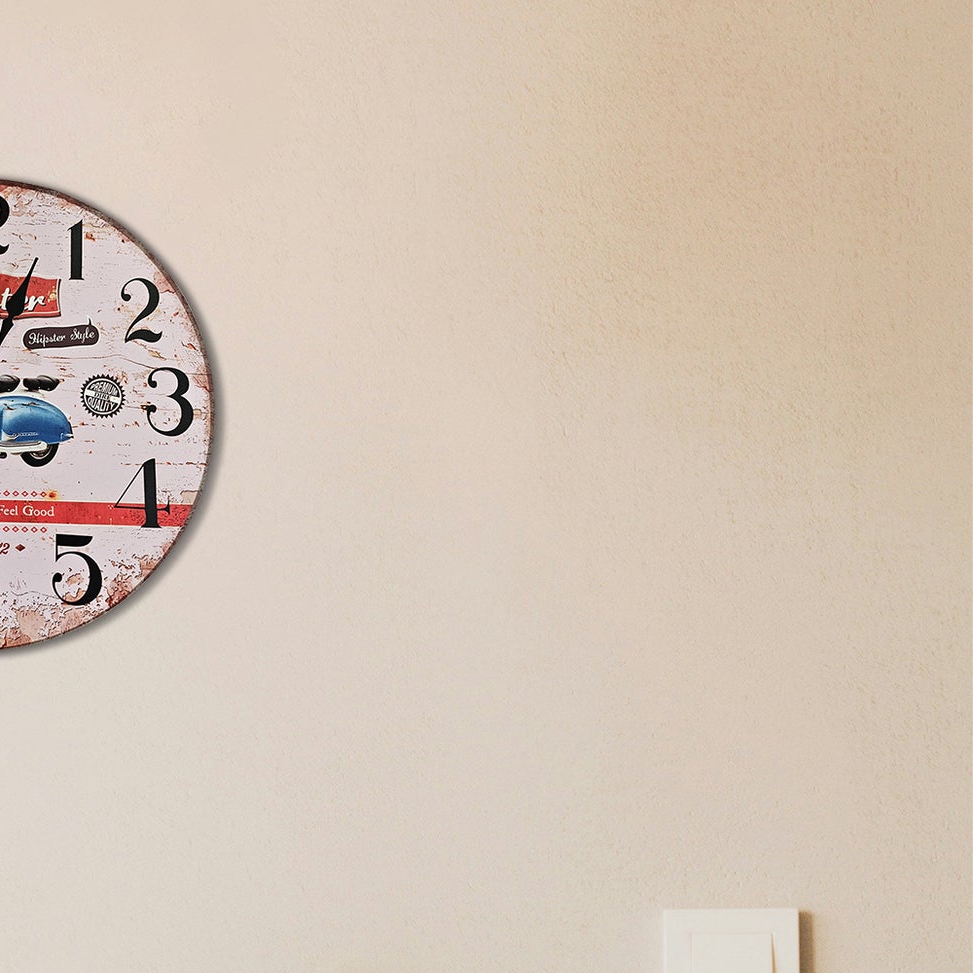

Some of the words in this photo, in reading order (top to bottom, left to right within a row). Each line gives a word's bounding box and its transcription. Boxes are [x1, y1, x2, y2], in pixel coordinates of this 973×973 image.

[67, 219, 85, 281] 1
[28, 332, 66, 348] Hipster
[70, 327, 96, 343] Style
[120, 277, 163, 344] 2
[87, 397, 116, 412] QUALITY
[89, 381, 118, 397] PREMIUM
[146, 367, 195, 437] 3
[22, 505, 55, 517] Good
[114, 458, 171, 529] 4
[52, 533, 103, 606] 5
